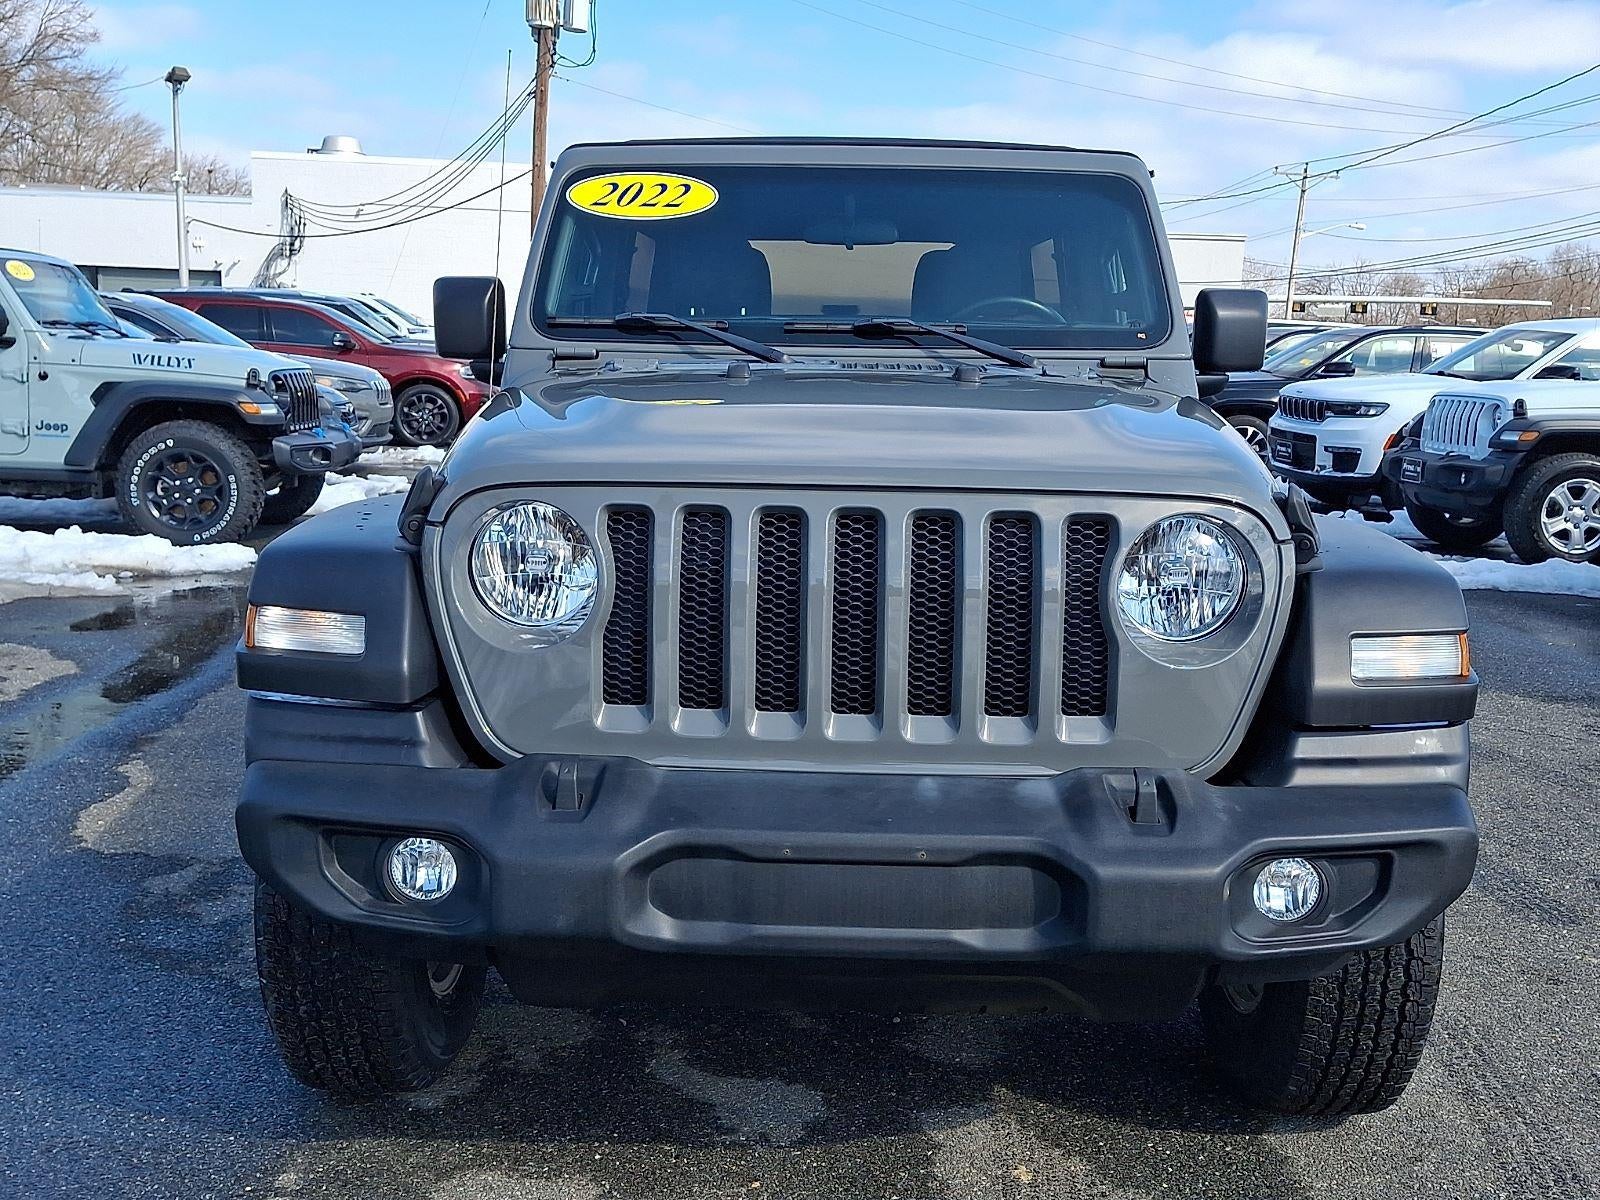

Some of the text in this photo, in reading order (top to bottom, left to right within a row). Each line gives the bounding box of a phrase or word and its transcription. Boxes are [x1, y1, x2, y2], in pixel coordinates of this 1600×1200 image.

[590, 181, 692, 208] 2022
[132, 352, 196, 369] WILLYS
[35, 419, 69, 434] Jeep
